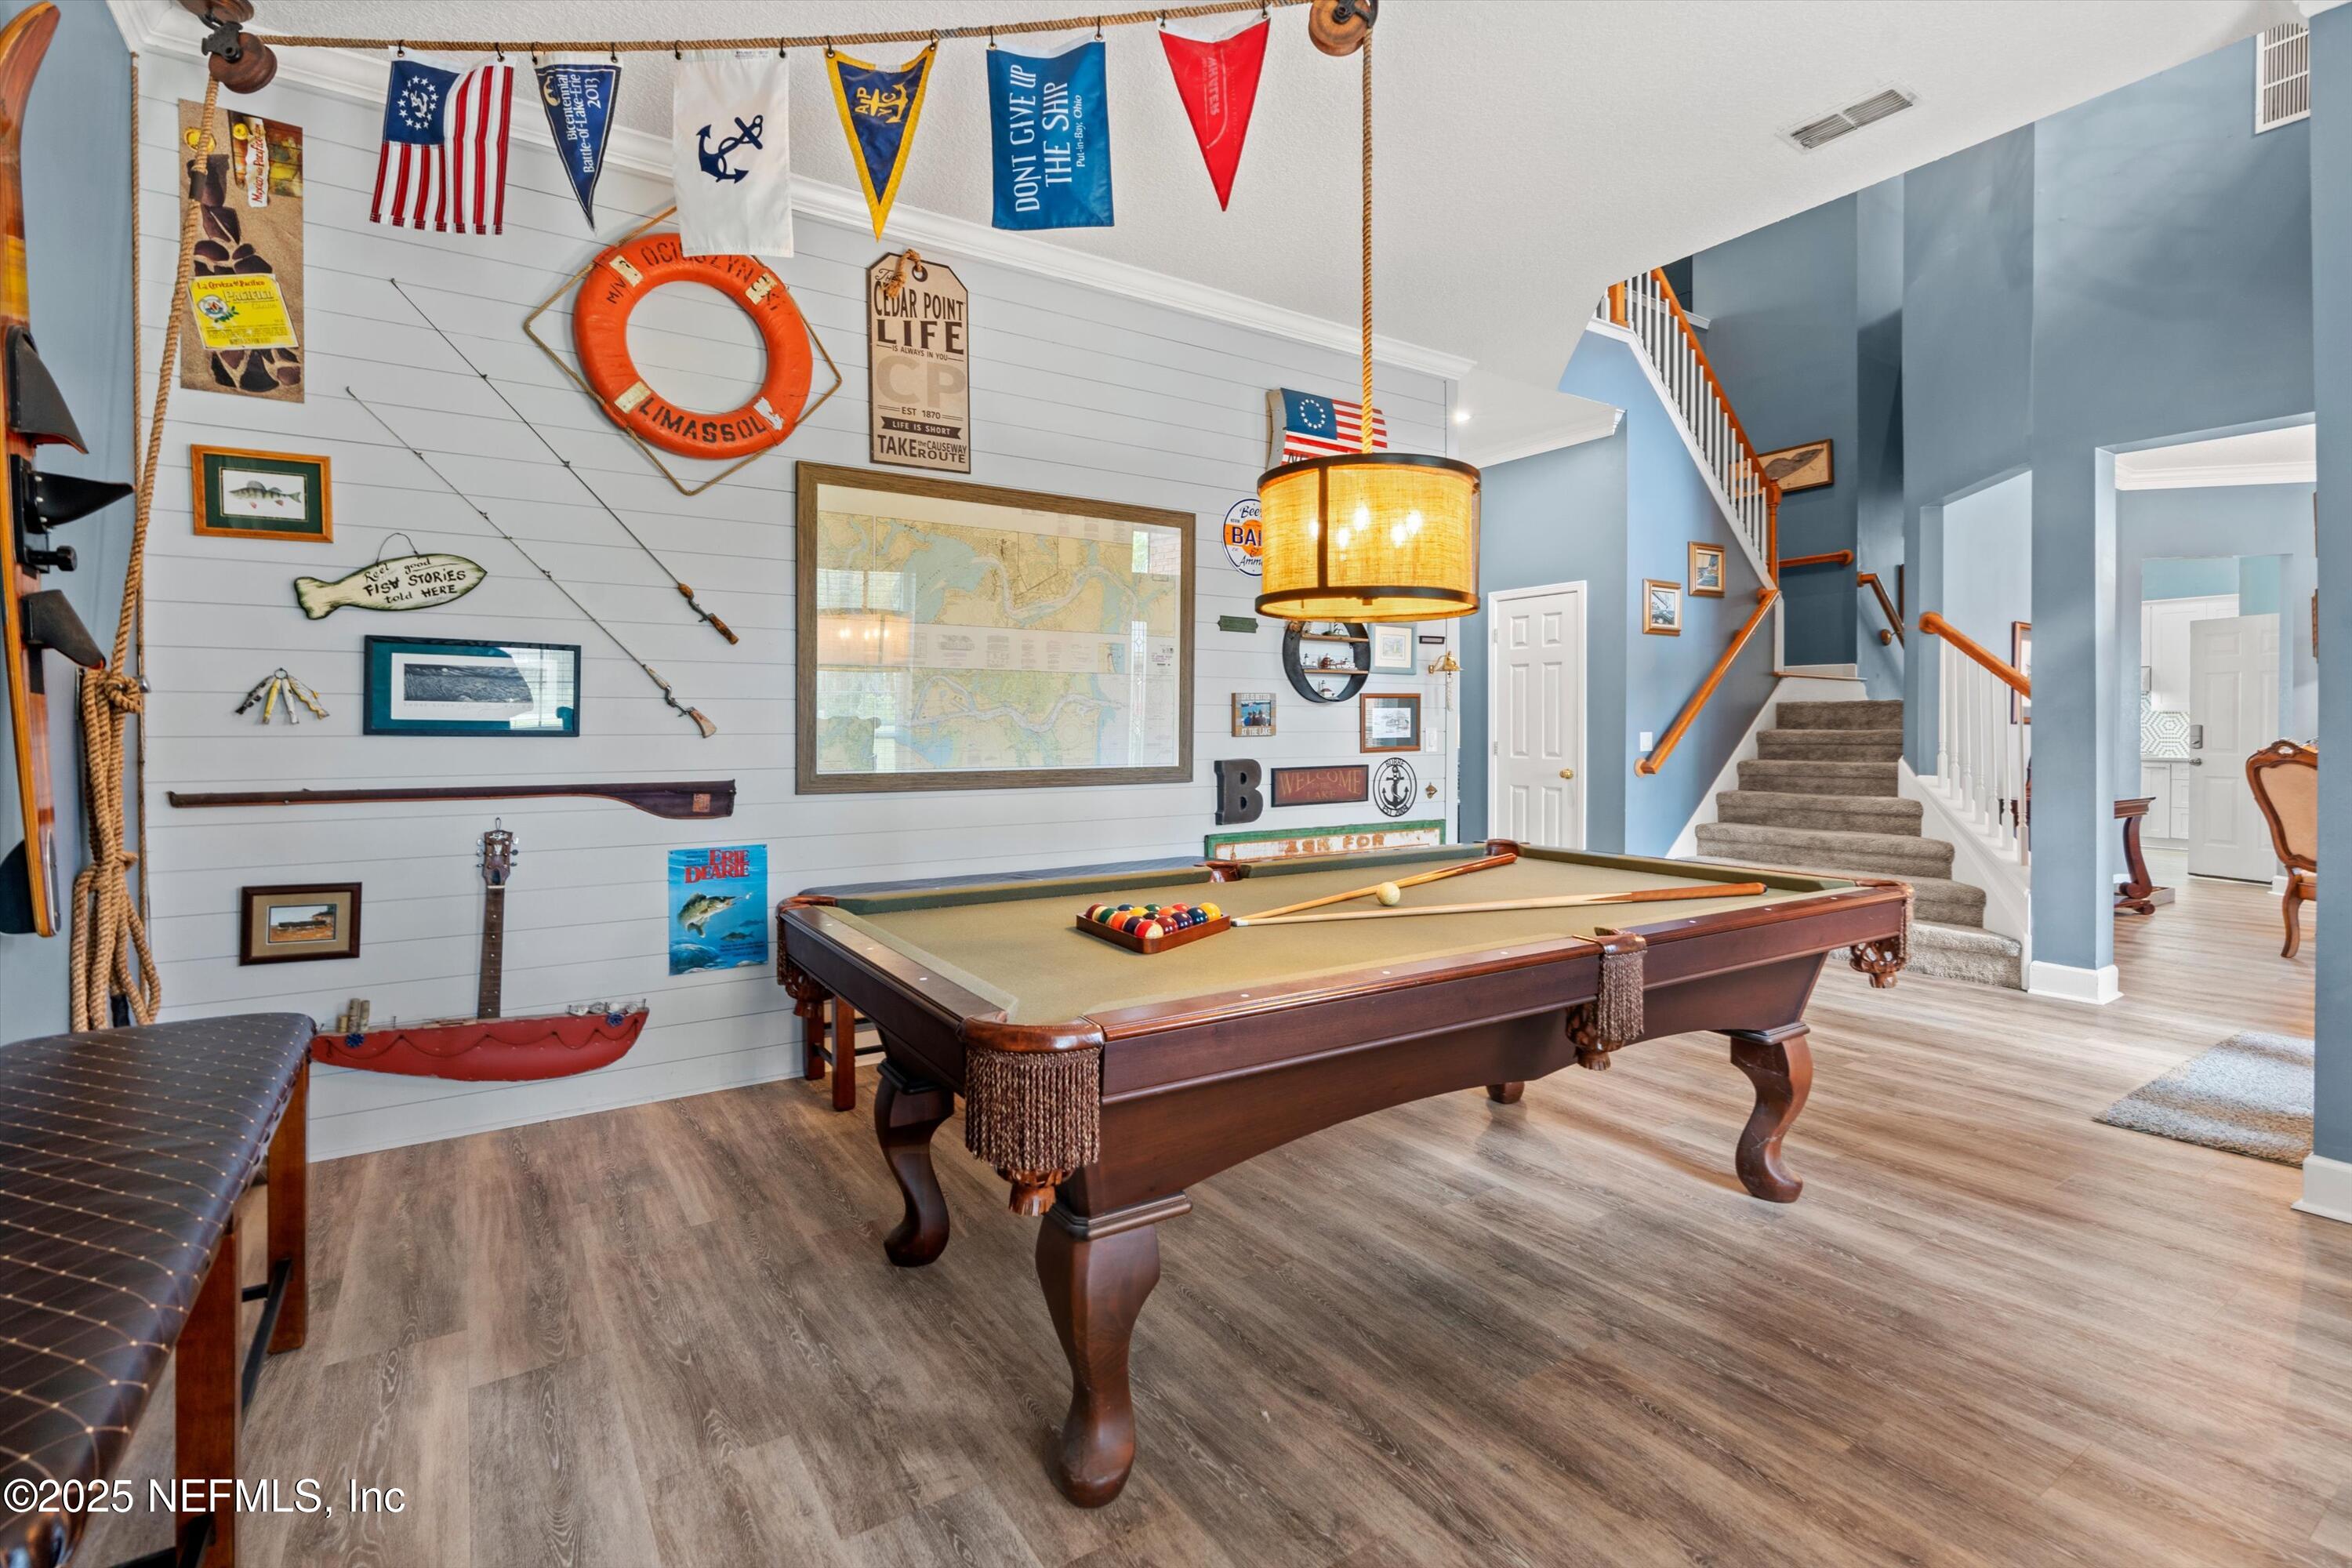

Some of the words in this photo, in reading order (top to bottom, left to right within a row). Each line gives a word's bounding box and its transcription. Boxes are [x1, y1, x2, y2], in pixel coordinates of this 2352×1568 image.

[1010, 64, 1036, 88] UP
[585, 78, 601, 109] 2013
[556, 74, 578, 140] Bicentennial
[1042, 82, 1069, 132] SHIP
[1073, 94, 1083, 118] Ohio
[1010, 93, 1036, 145] GIVE
[1044, 141, 1073, 187] THE
[252, 177, 265, 203] Mexico
[1011, 155, 1041, 212] DONT
[606, 277, 626, 304] M/V
[924, 292, 964, 321] POINT
[877, 319, 964, 354] LIFE
[901, 347, 924, 357] ALWAYS
[876, 355, 967, 408] CP
[639, 397, 767, 443] LIMASSOL
[902, 407, 916, 416] EST
[922, 410, 941, 419] 1870
[892, 421, 909, 430] LIFE
[925, 425, 950, 435] SHORT
[877, 434, 918, 458] TAKE
[927, 440, 967, 454] CAUSEWAY
[918, 448, 966, 463] ROUTE
[1240, 506, 1261, 518] Bee
[1232, 526, 1261, 546] BAI
[404, 557, 431, 573] good
[1239, 554, 1262, 567] Amm
[384, 592, 413, 603] told
[421, 584, 458, 598] HERE
[1214, 759, 1264, 825] B
[1279, 770, 1362, 797] WELCOME
[1306, 790, 1336, 799] LAKE
[1343, 833, 1385, 848] FOR
[709, 849, 750, 866] ERIE
[684, 864, 750, 884] DEARIE
